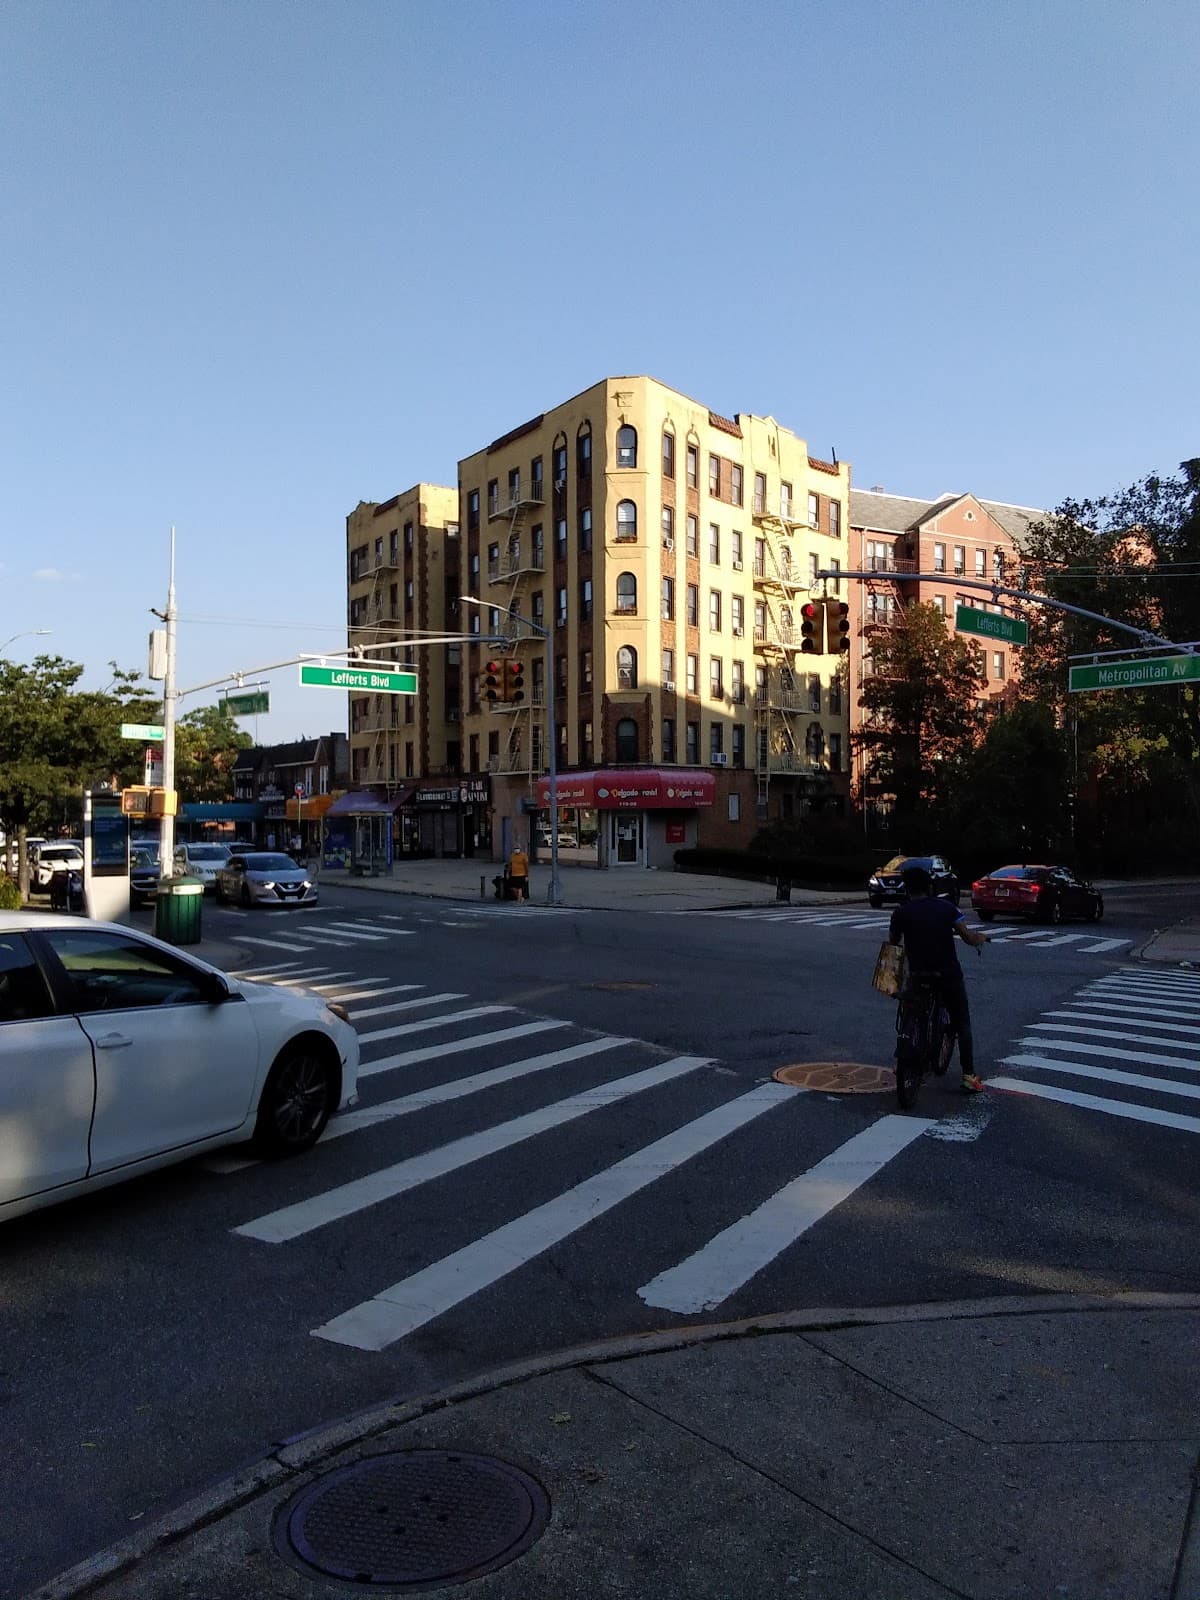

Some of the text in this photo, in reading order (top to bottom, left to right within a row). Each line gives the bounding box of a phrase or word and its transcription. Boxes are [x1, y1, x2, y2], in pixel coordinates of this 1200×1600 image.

[977, 616, 1013, 637] Lefferts Blvd
[331, 671, 390, 688] Lefferts Blvd
[1098, 663, 1187, 684] Metropolitan Av
